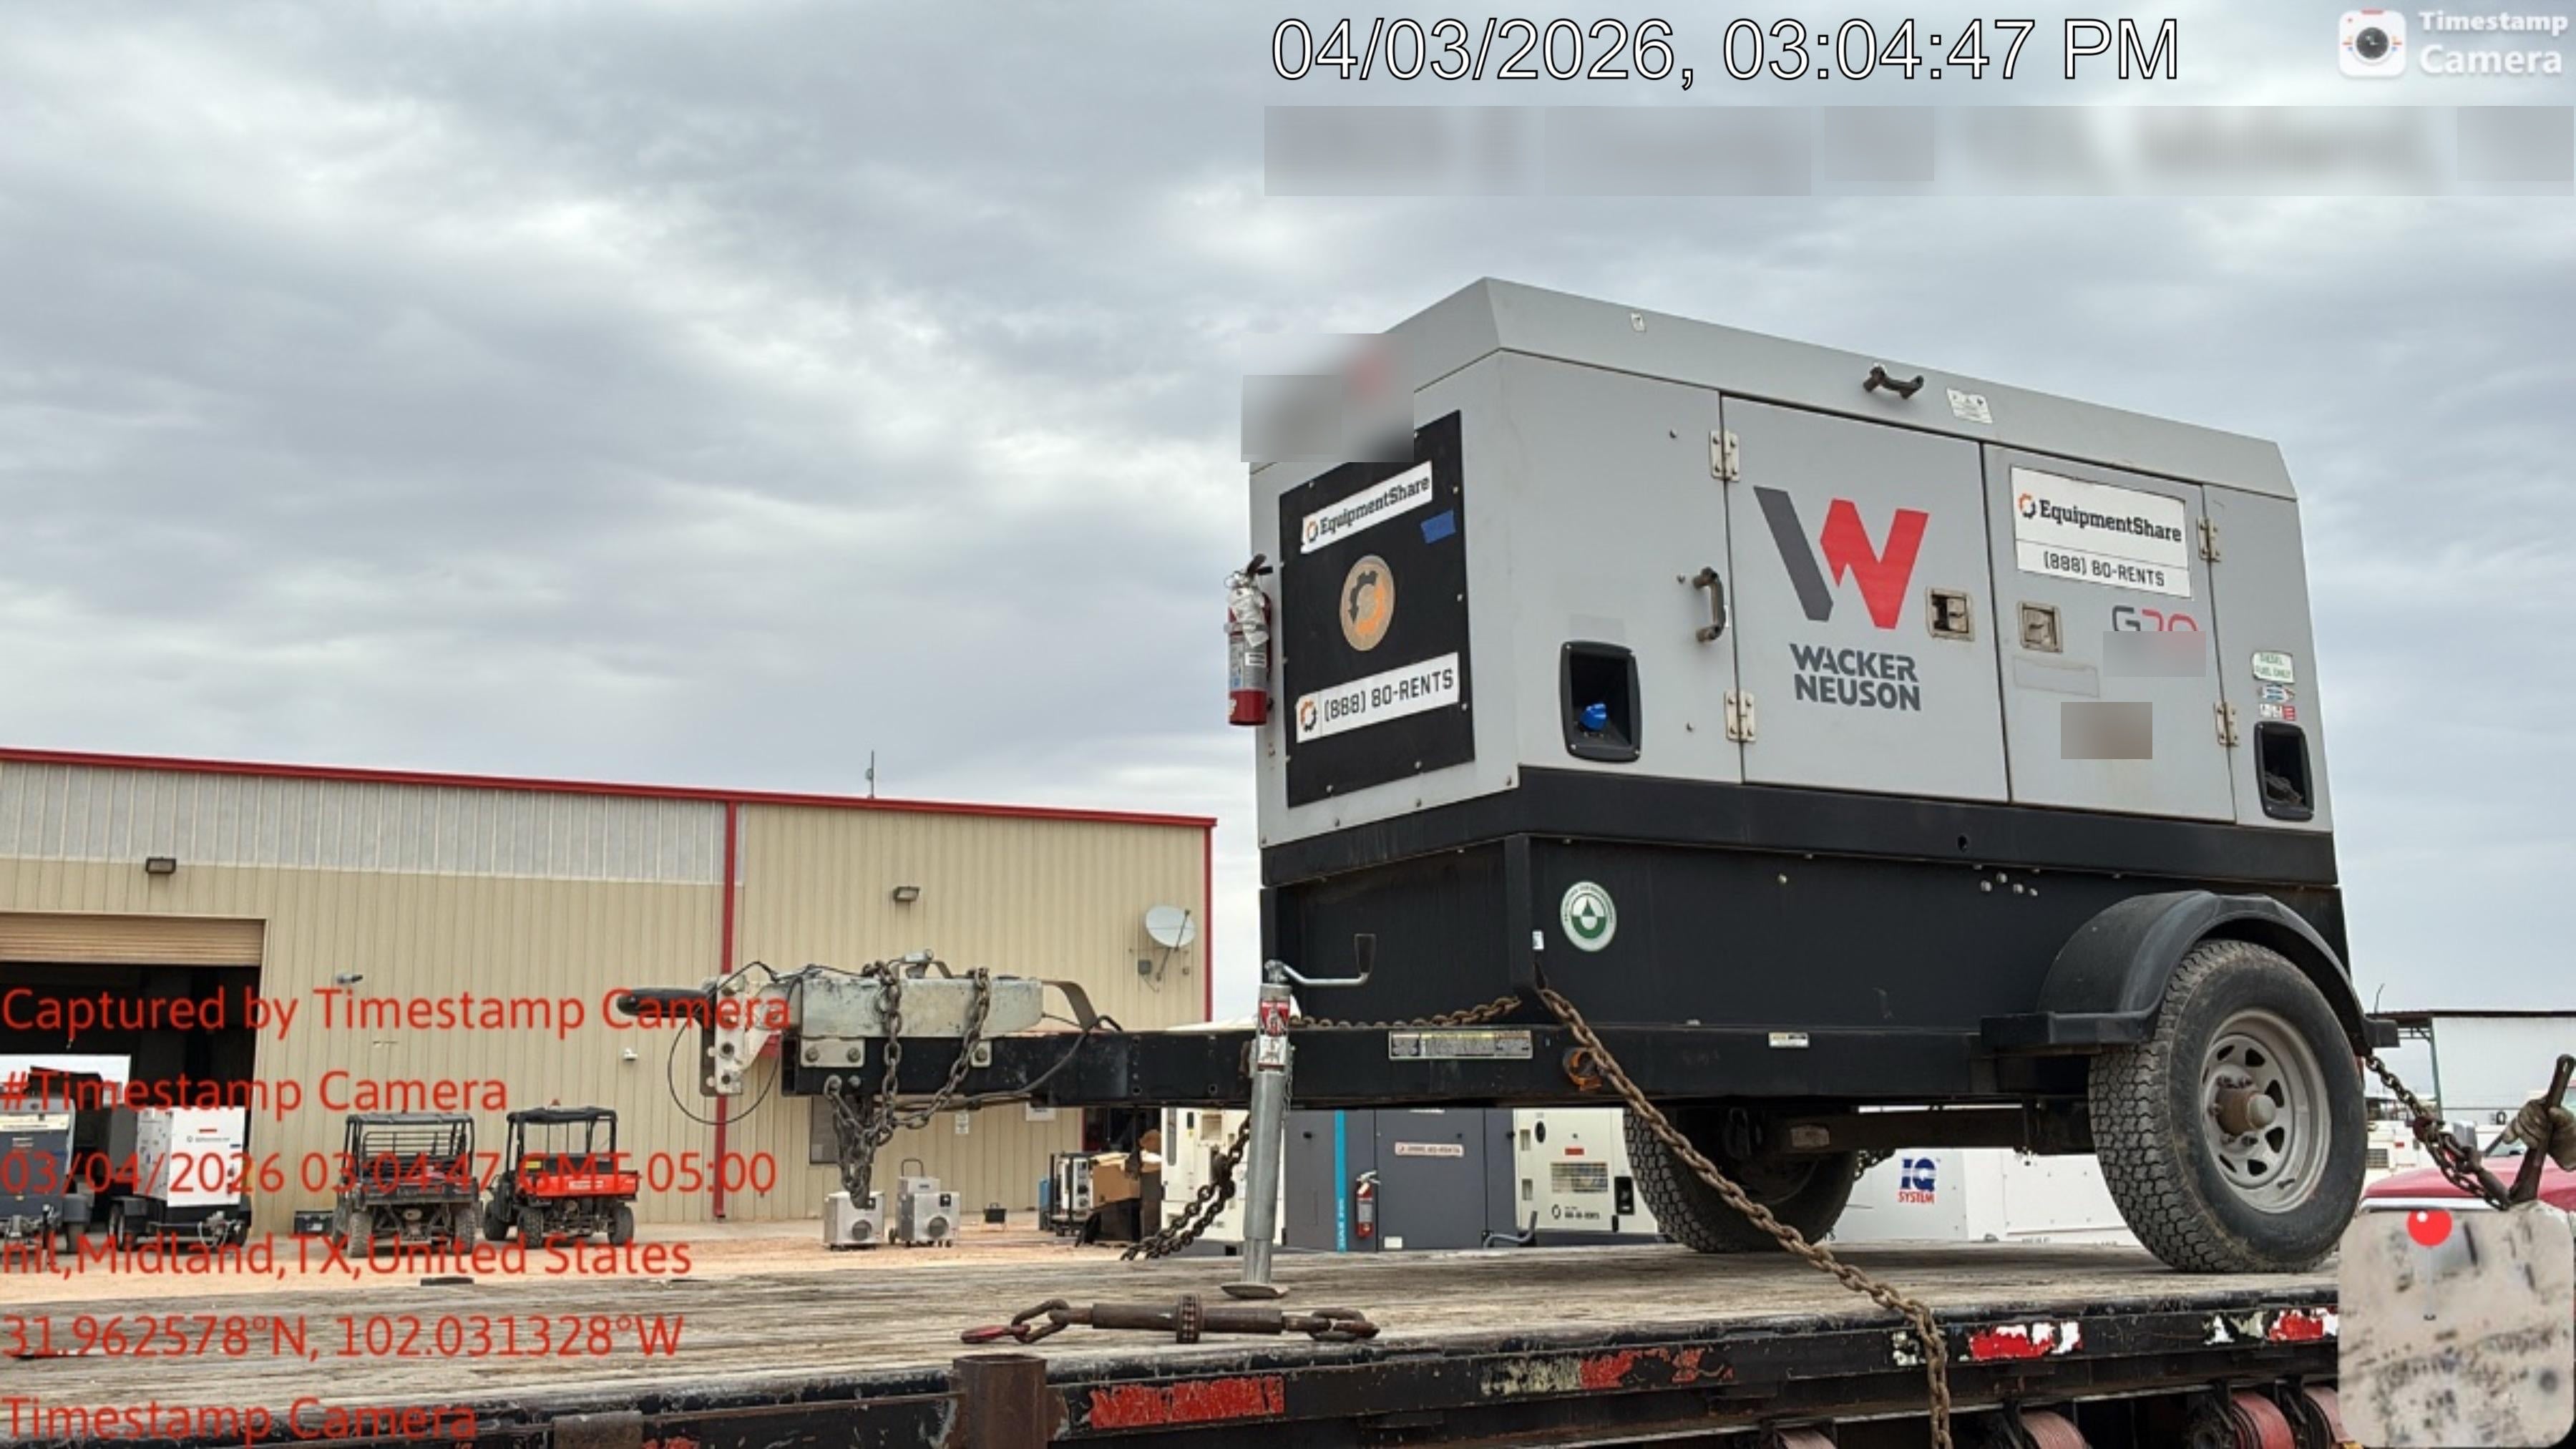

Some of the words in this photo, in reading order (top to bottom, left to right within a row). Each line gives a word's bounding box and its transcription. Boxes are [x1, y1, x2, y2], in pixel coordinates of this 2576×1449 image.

[1320, 476, 1430, 535] EquipmentShare
[2039, 499, 2182, 542] EquipmentShare
[2044, 550, 2087, 576] (888)
[2092, 560, 2165, 587] 80-RENTS
[1789, 643, 1919, 683] WACKER
[1324, 690, 1366, 722] (888)
[1370, 668, 1454, 708] 80-RENTS
[1794, 673, 1921, 711] NEUSON
[1901, 1157, 1937, 1192] IQ
[1898, 1191, 1936, 1205] SYSTEM
